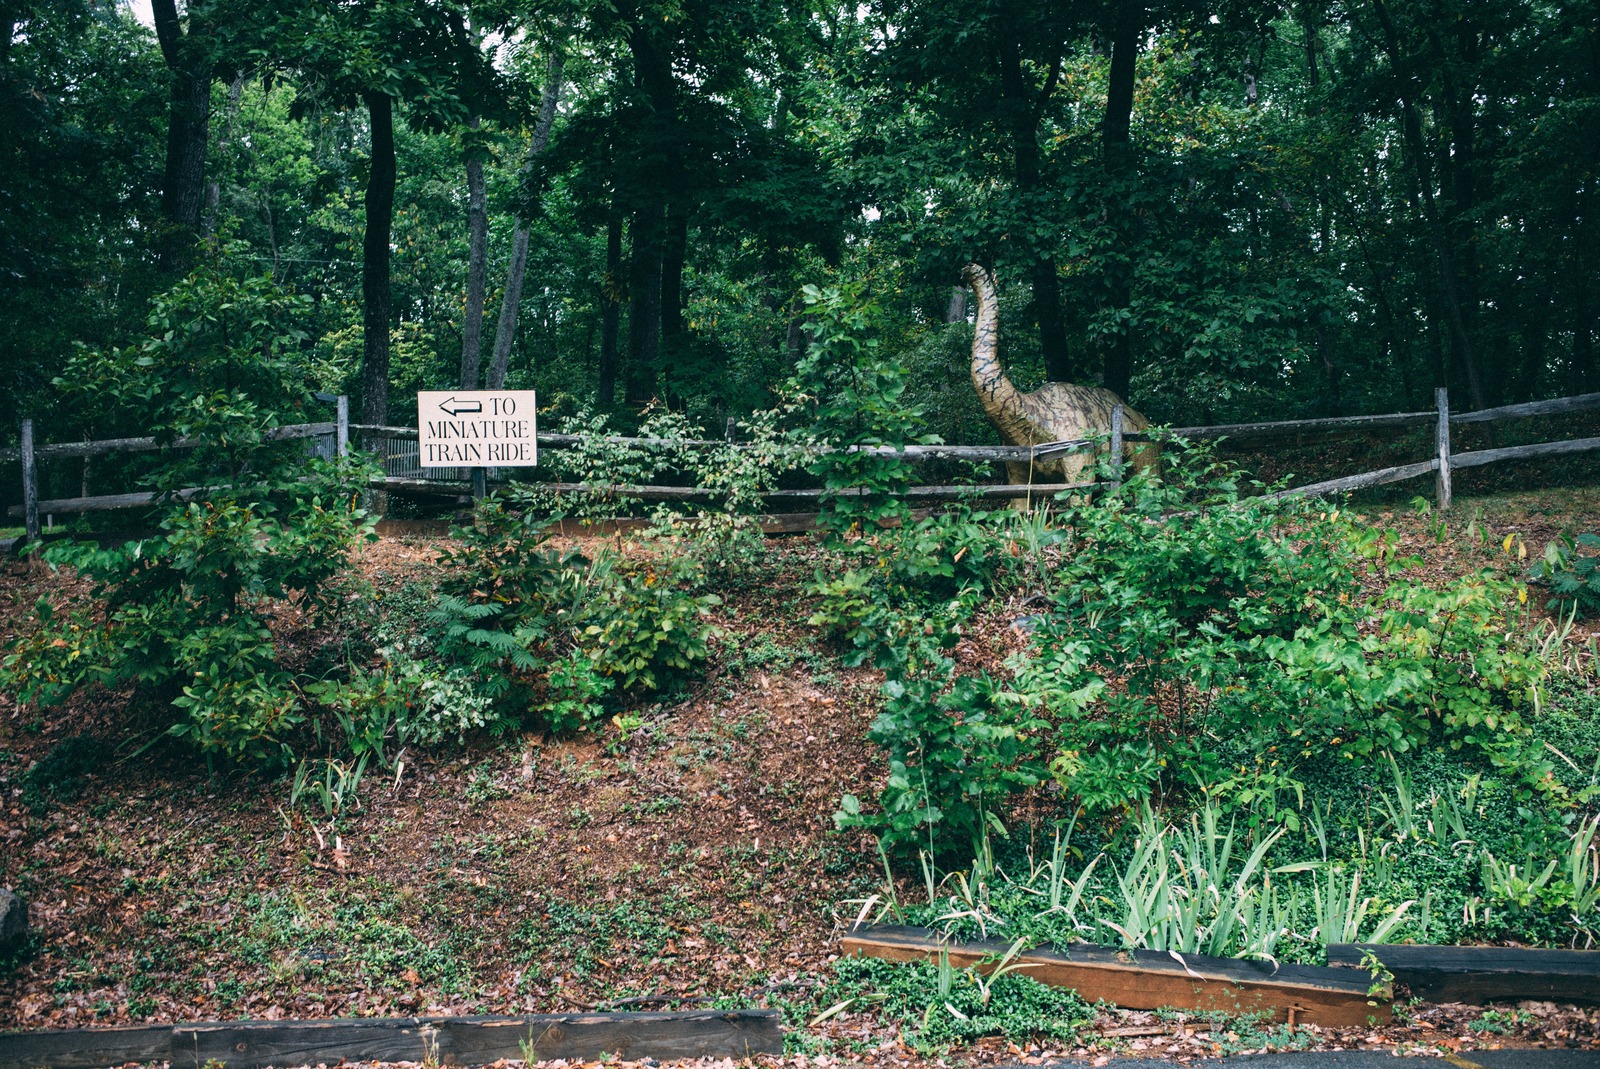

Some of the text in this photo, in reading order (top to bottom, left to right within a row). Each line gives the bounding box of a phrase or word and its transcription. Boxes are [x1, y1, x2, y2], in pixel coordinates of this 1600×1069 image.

[490, 397, 516, 416] TO
[428, 420, 530, 439] MINIATURE
[425, 442, 531, 462] TRAIN RIDE
